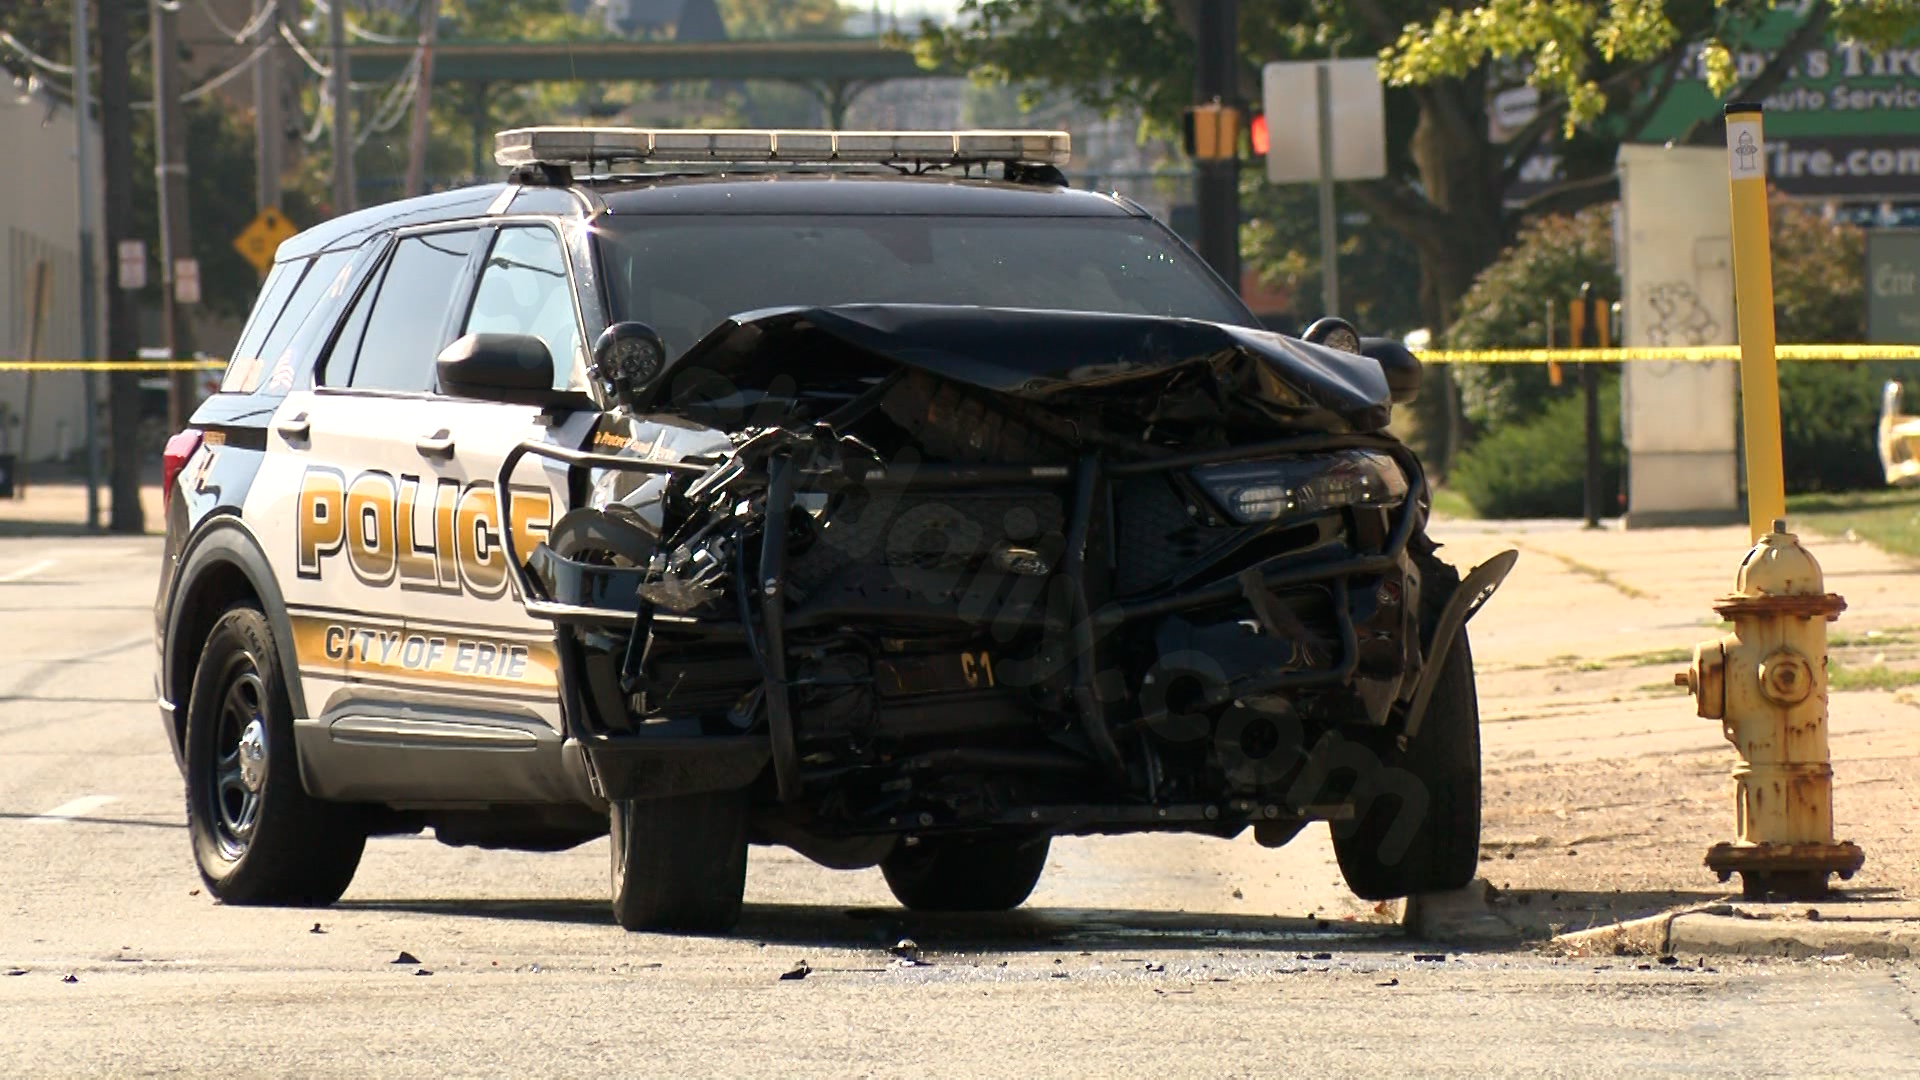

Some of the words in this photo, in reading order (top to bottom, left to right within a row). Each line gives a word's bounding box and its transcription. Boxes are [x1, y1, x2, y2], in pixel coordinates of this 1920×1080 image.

[1831, 84, 1920, 110] Servic
[297, 464, 553, 602] POLICE
[325, 624, 400, 664] CITY
[402, 633, 447, 671] OF
[452, 639, 529, 679] ERIE
[961, 649, 995, 688] C1
